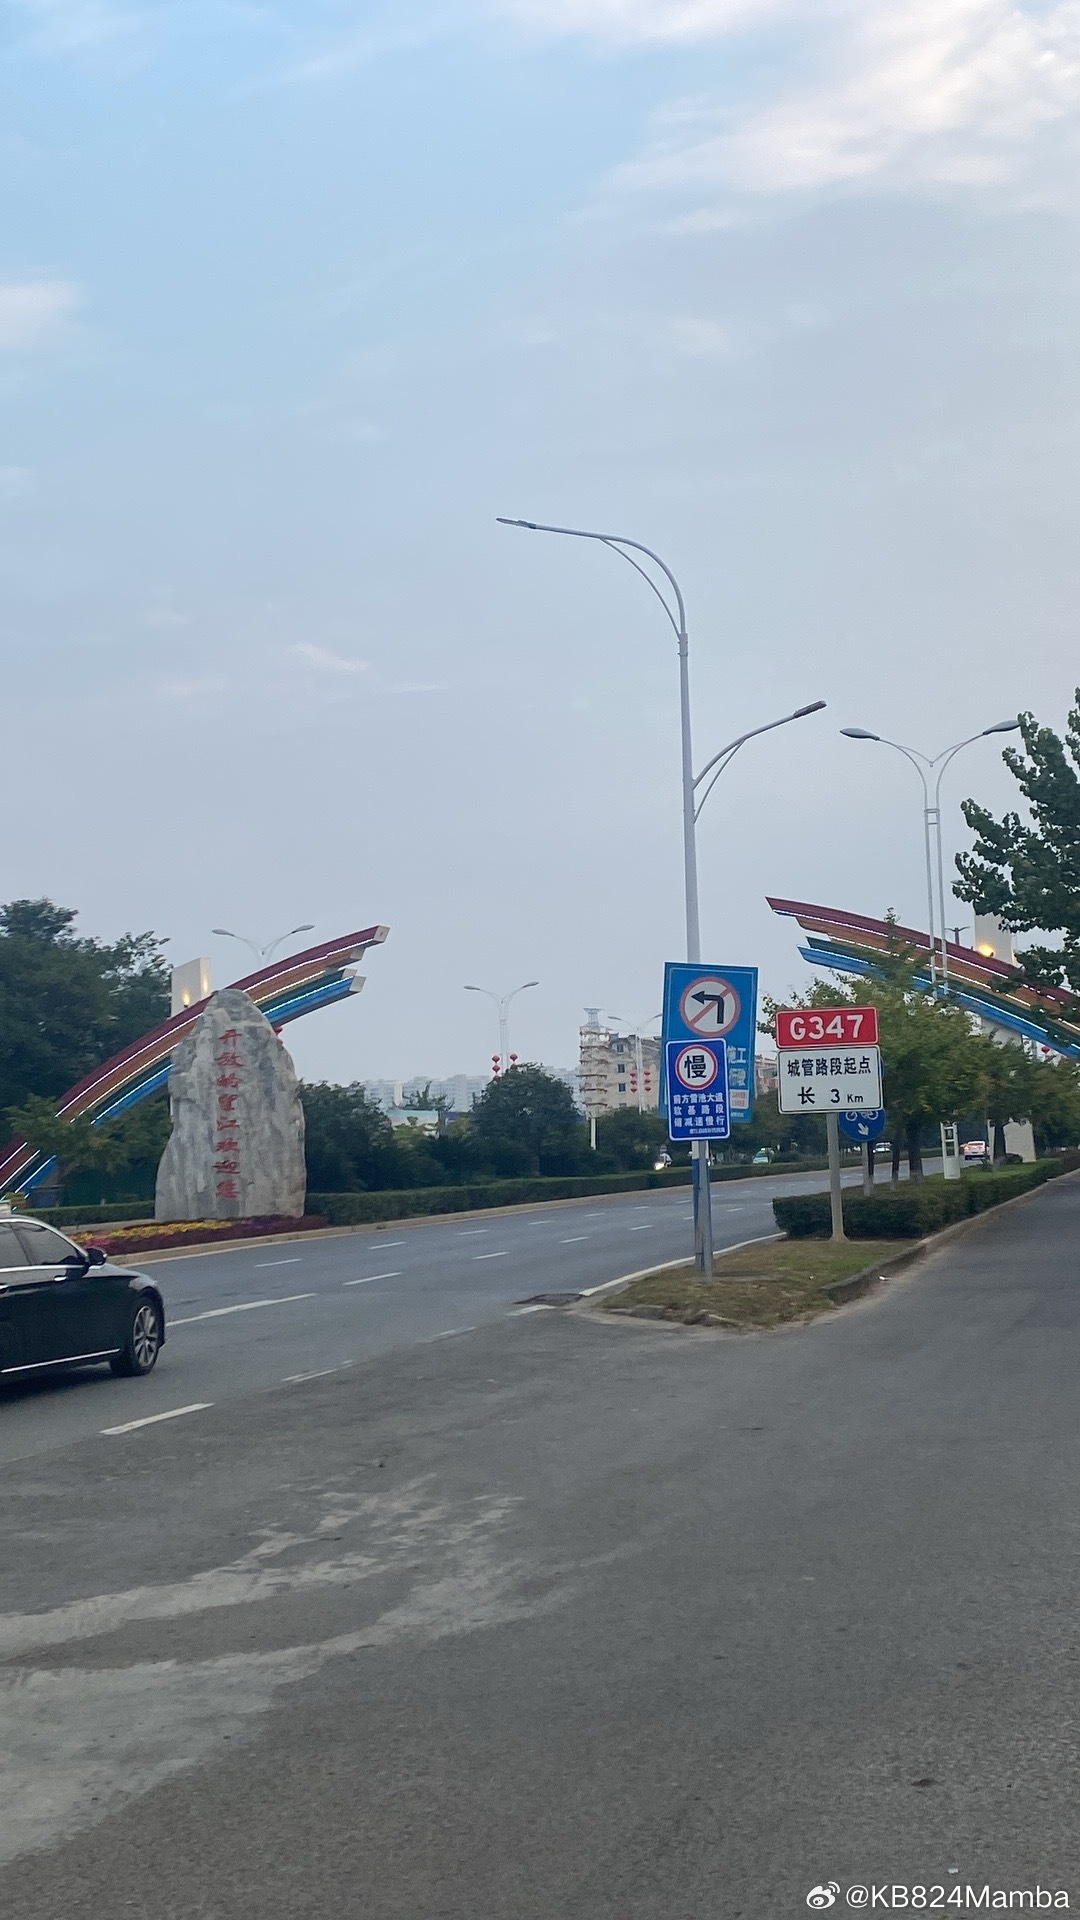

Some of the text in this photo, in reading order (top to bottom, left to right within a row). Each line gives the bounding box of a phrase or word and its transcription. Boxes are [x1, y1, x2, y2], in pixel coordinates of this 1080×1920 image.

[790, 1014, 863, 1040] G347
[684, 1055, 707, 1079] 慢
[787, 1056, 871, 1077] 城管路段起点
[797, 1087, 864, 1105] 长 3 Km
